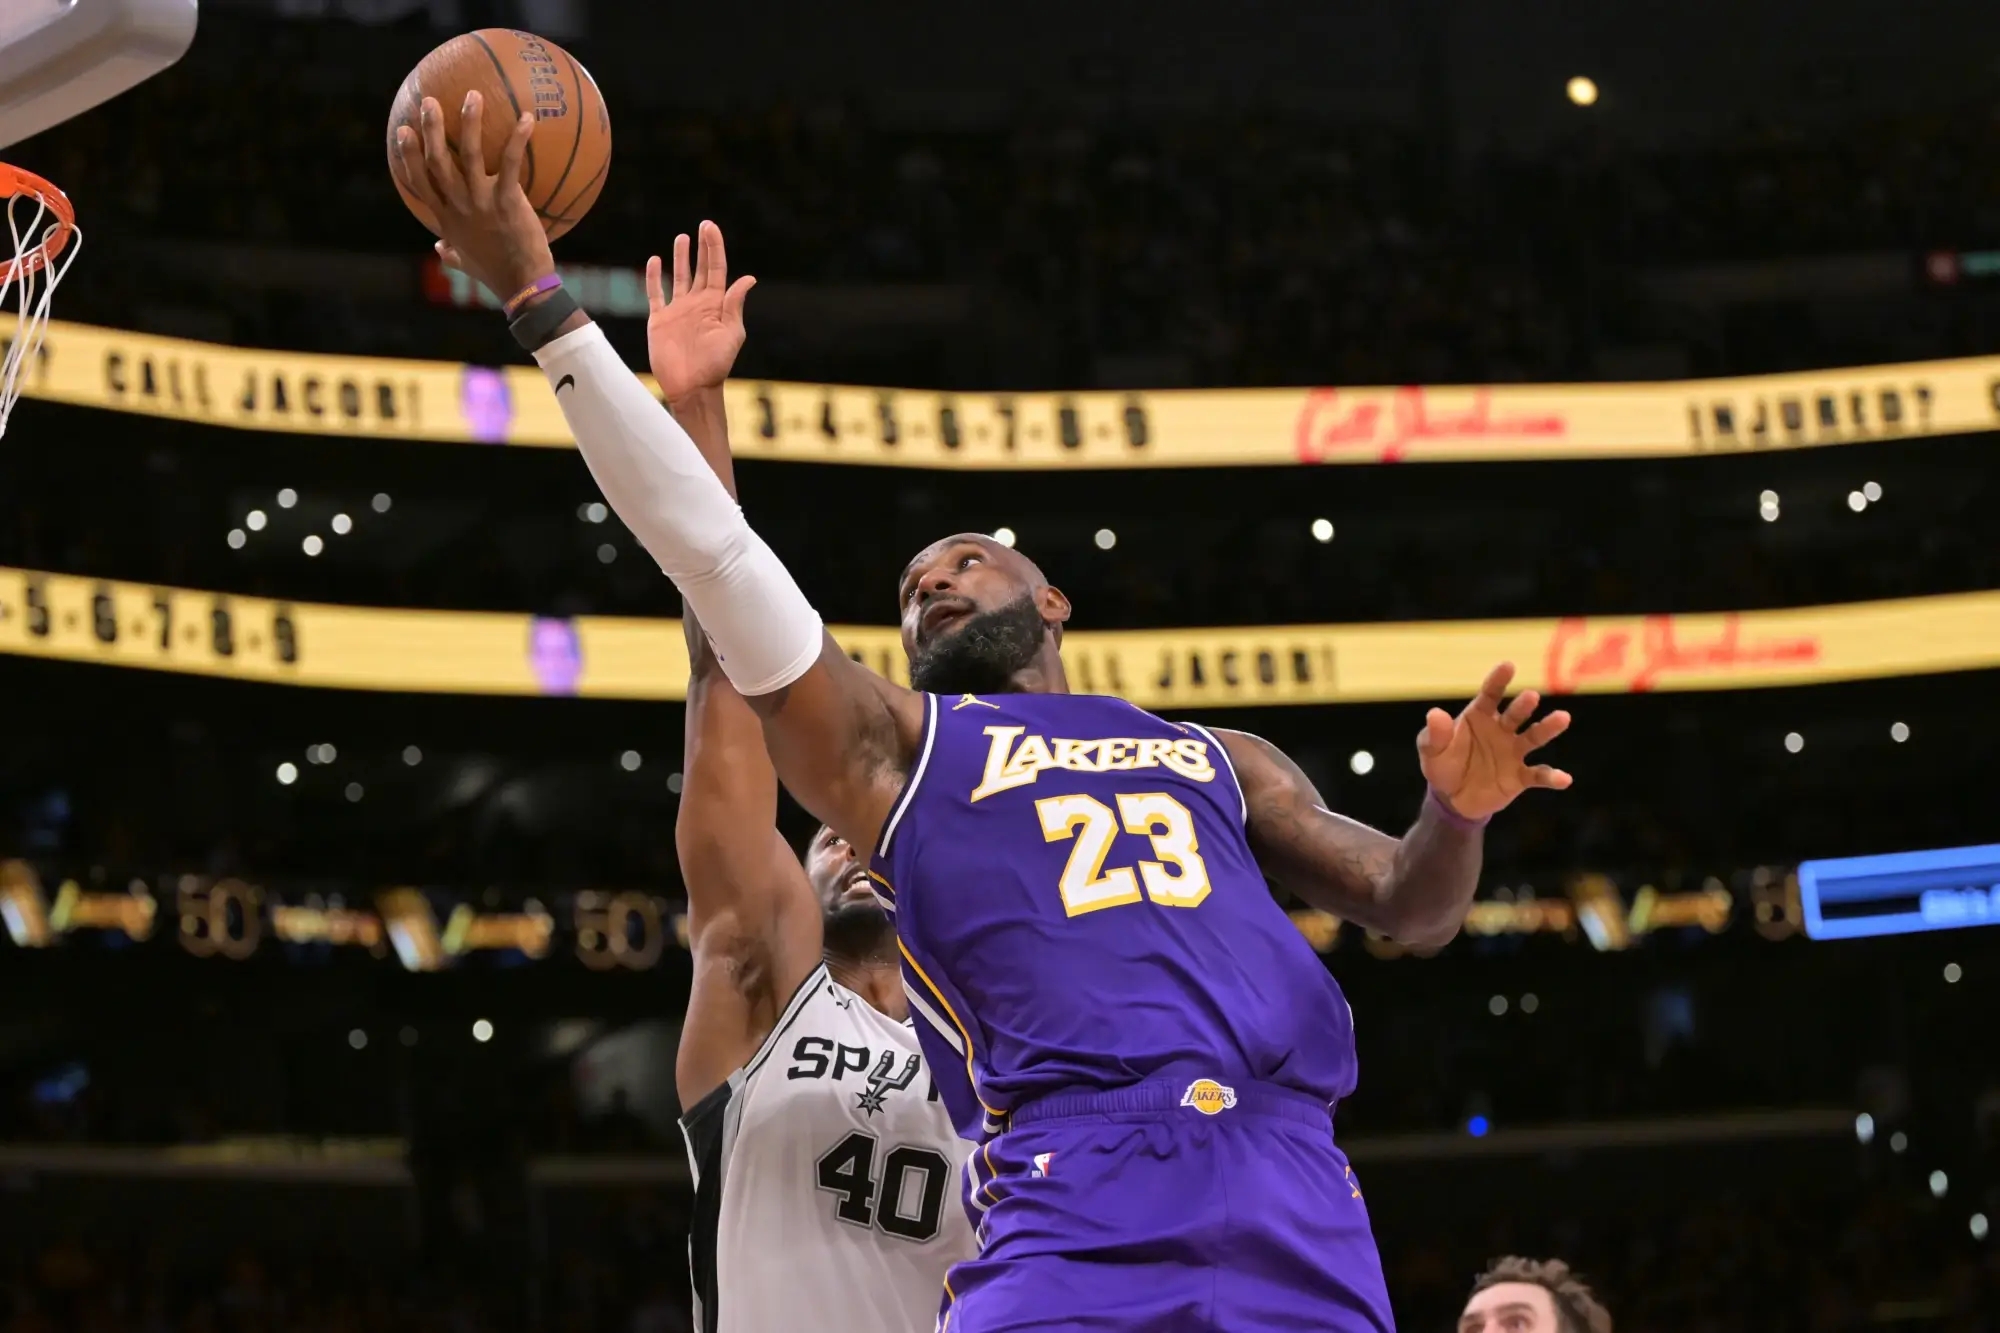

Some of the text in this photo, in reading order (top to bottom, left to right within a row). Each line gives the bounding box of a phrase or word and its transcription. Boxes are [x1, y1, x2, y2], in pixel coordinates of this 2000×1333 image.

[970, 725, 1217, 803] LAKERS
[1034, 792, 1212, 918] 23
[787, 1036, 940, 1118] SPU
[1184, 1085, 1235, 1107] LAKERS
[815, 1129, 952, 1244] 40
